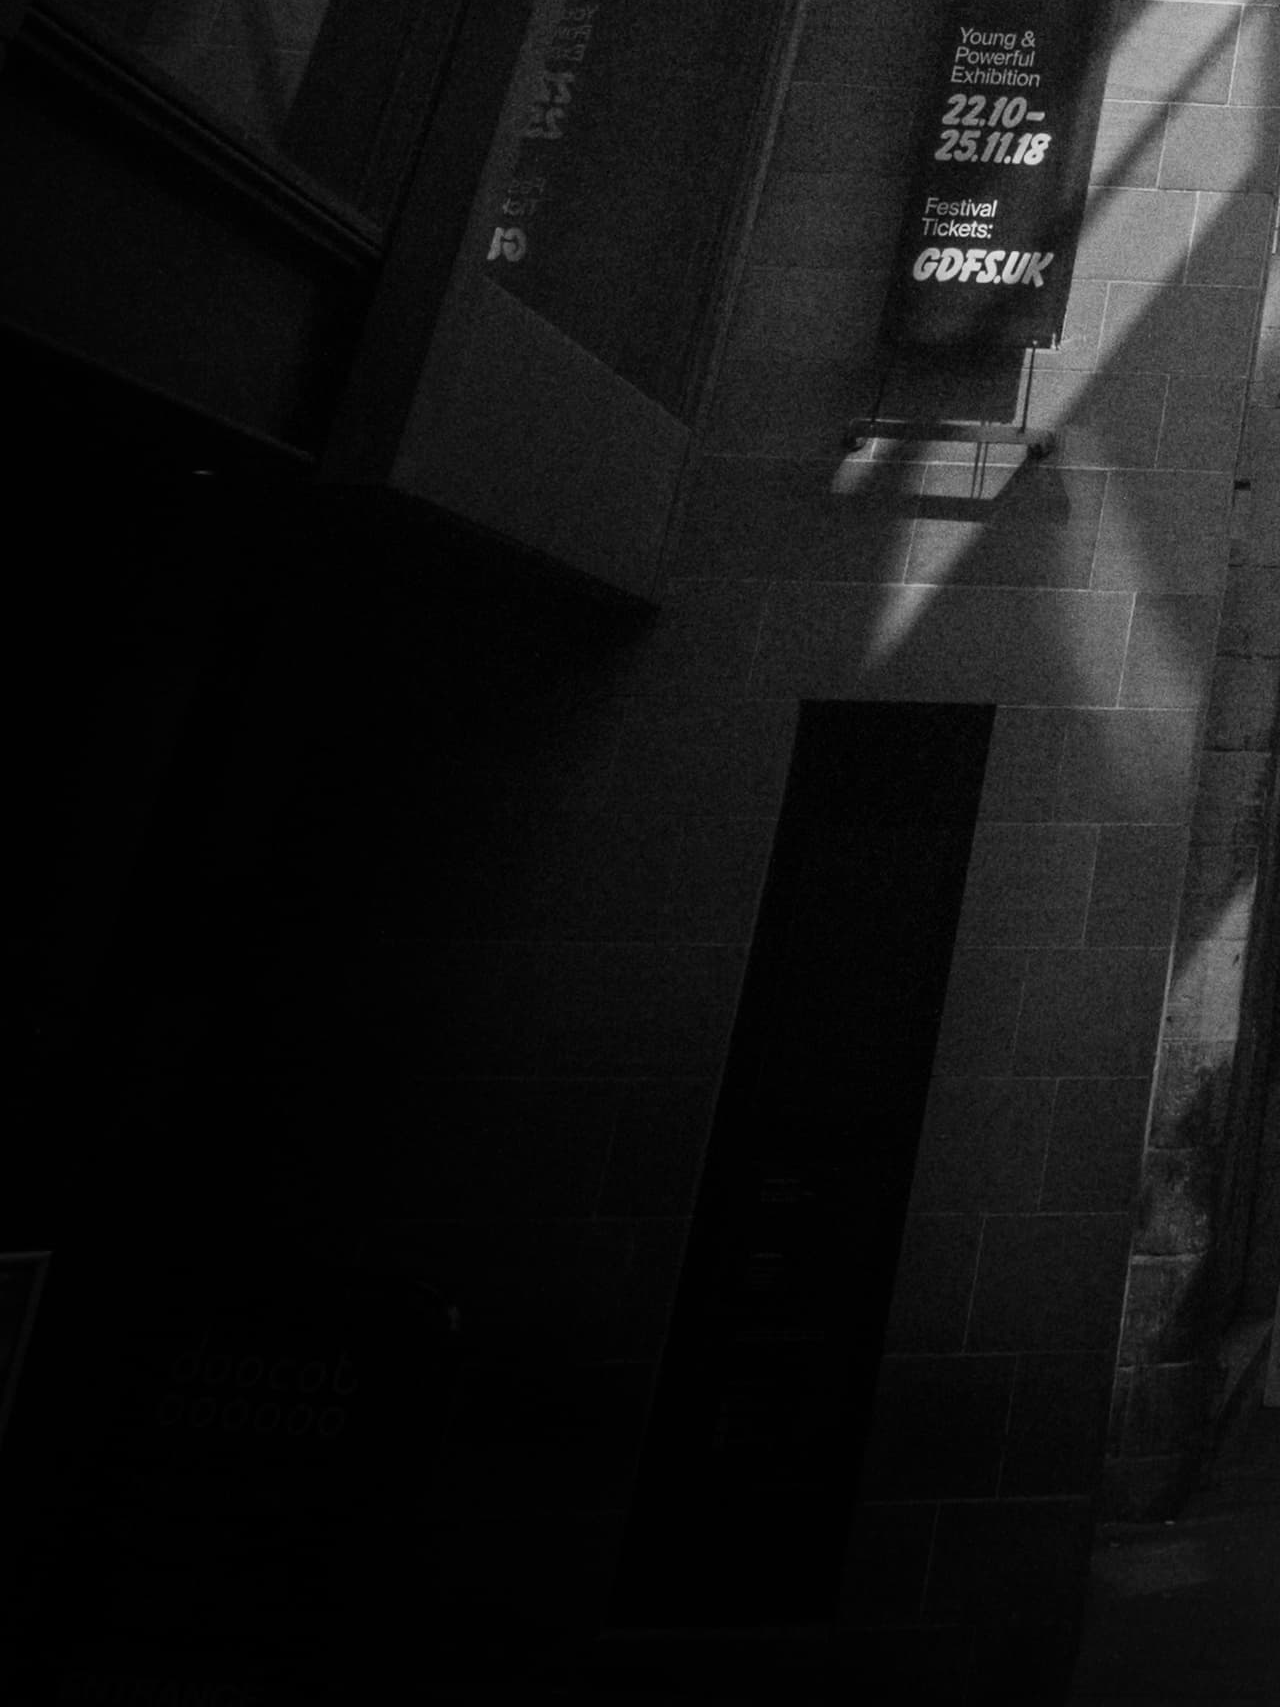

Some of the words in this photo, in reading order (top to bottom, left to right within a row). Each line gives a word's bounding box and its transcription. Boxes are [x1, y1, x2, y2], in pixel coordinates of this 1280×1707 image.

[960, 27, 1014, 50] Young
[1020, 30, 1036, 47] &
[955, 47, 1035, 68] Powerful
[950, 67, 1040, 88] Exhibition
[935, 130, 1052, 166] 25.11.18
[925, 196, 998, 218] Festival
[921, 217, 993, 239] Tickets:
[913, 247, 1053, 288] GDFS.UK
